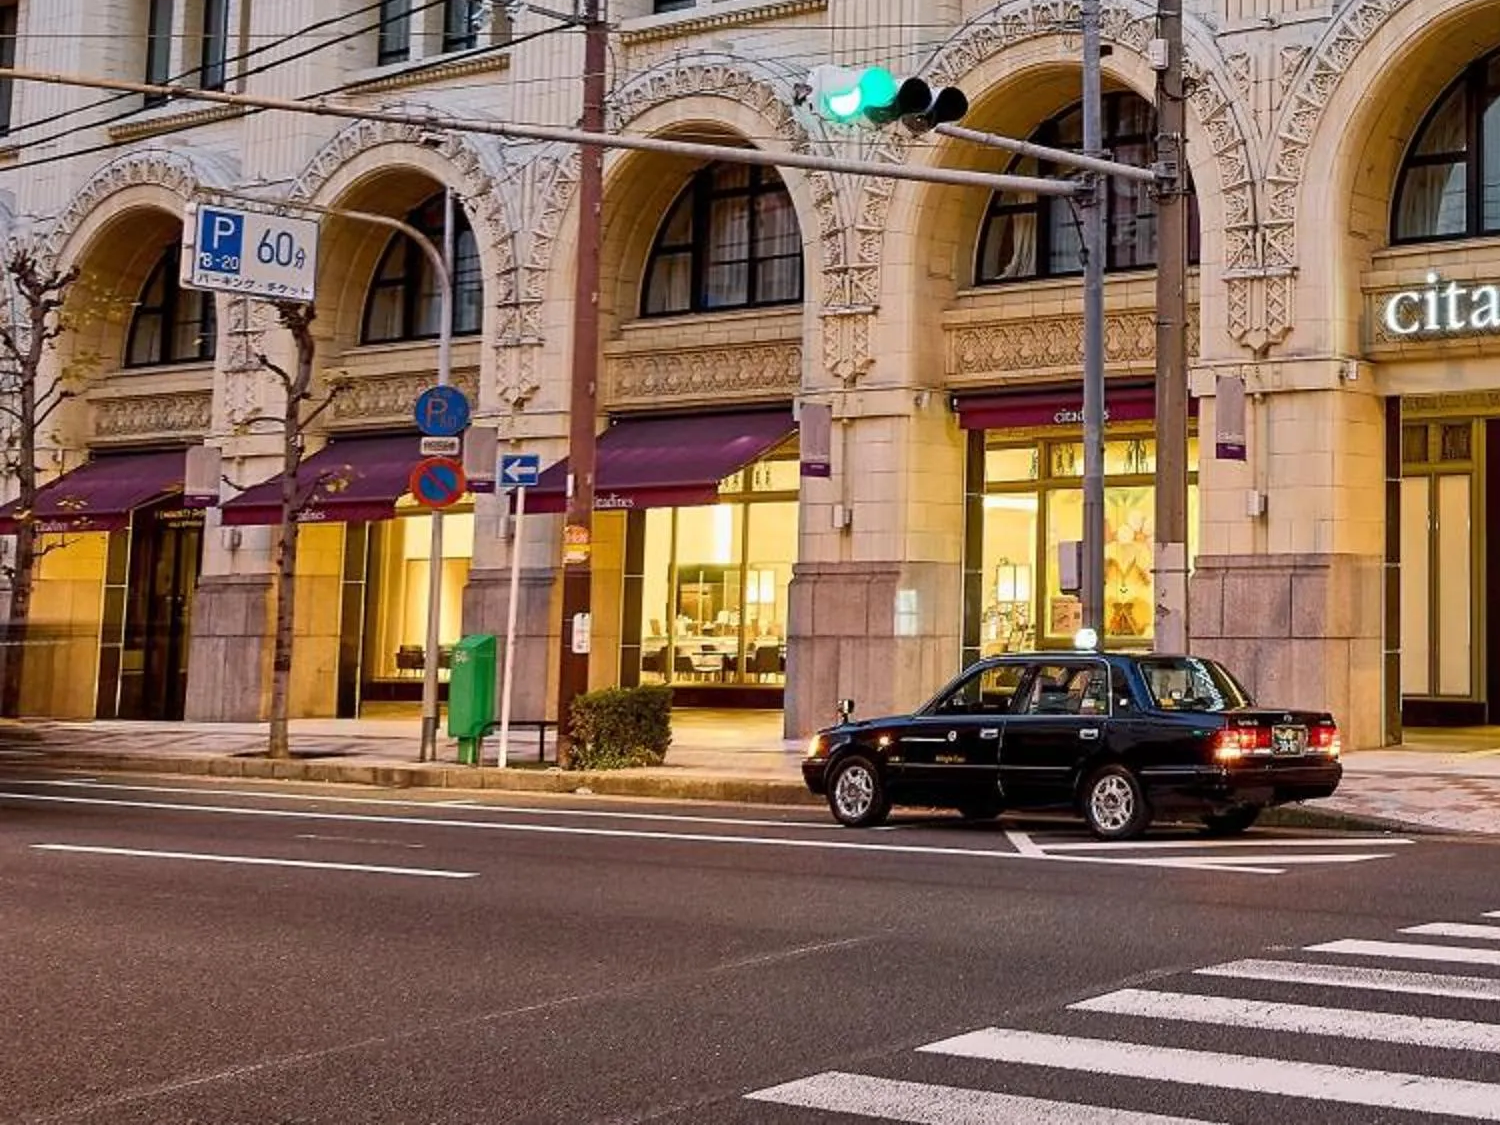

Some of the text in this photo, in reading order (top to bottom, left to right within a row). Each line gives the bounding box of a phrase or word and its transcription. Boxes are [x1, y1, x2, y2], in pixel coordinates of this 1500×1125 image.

[213, 216, 235, 250] P
[257, 228, 306, 269] 60分
[1053, 407, 1110, 424] citads
